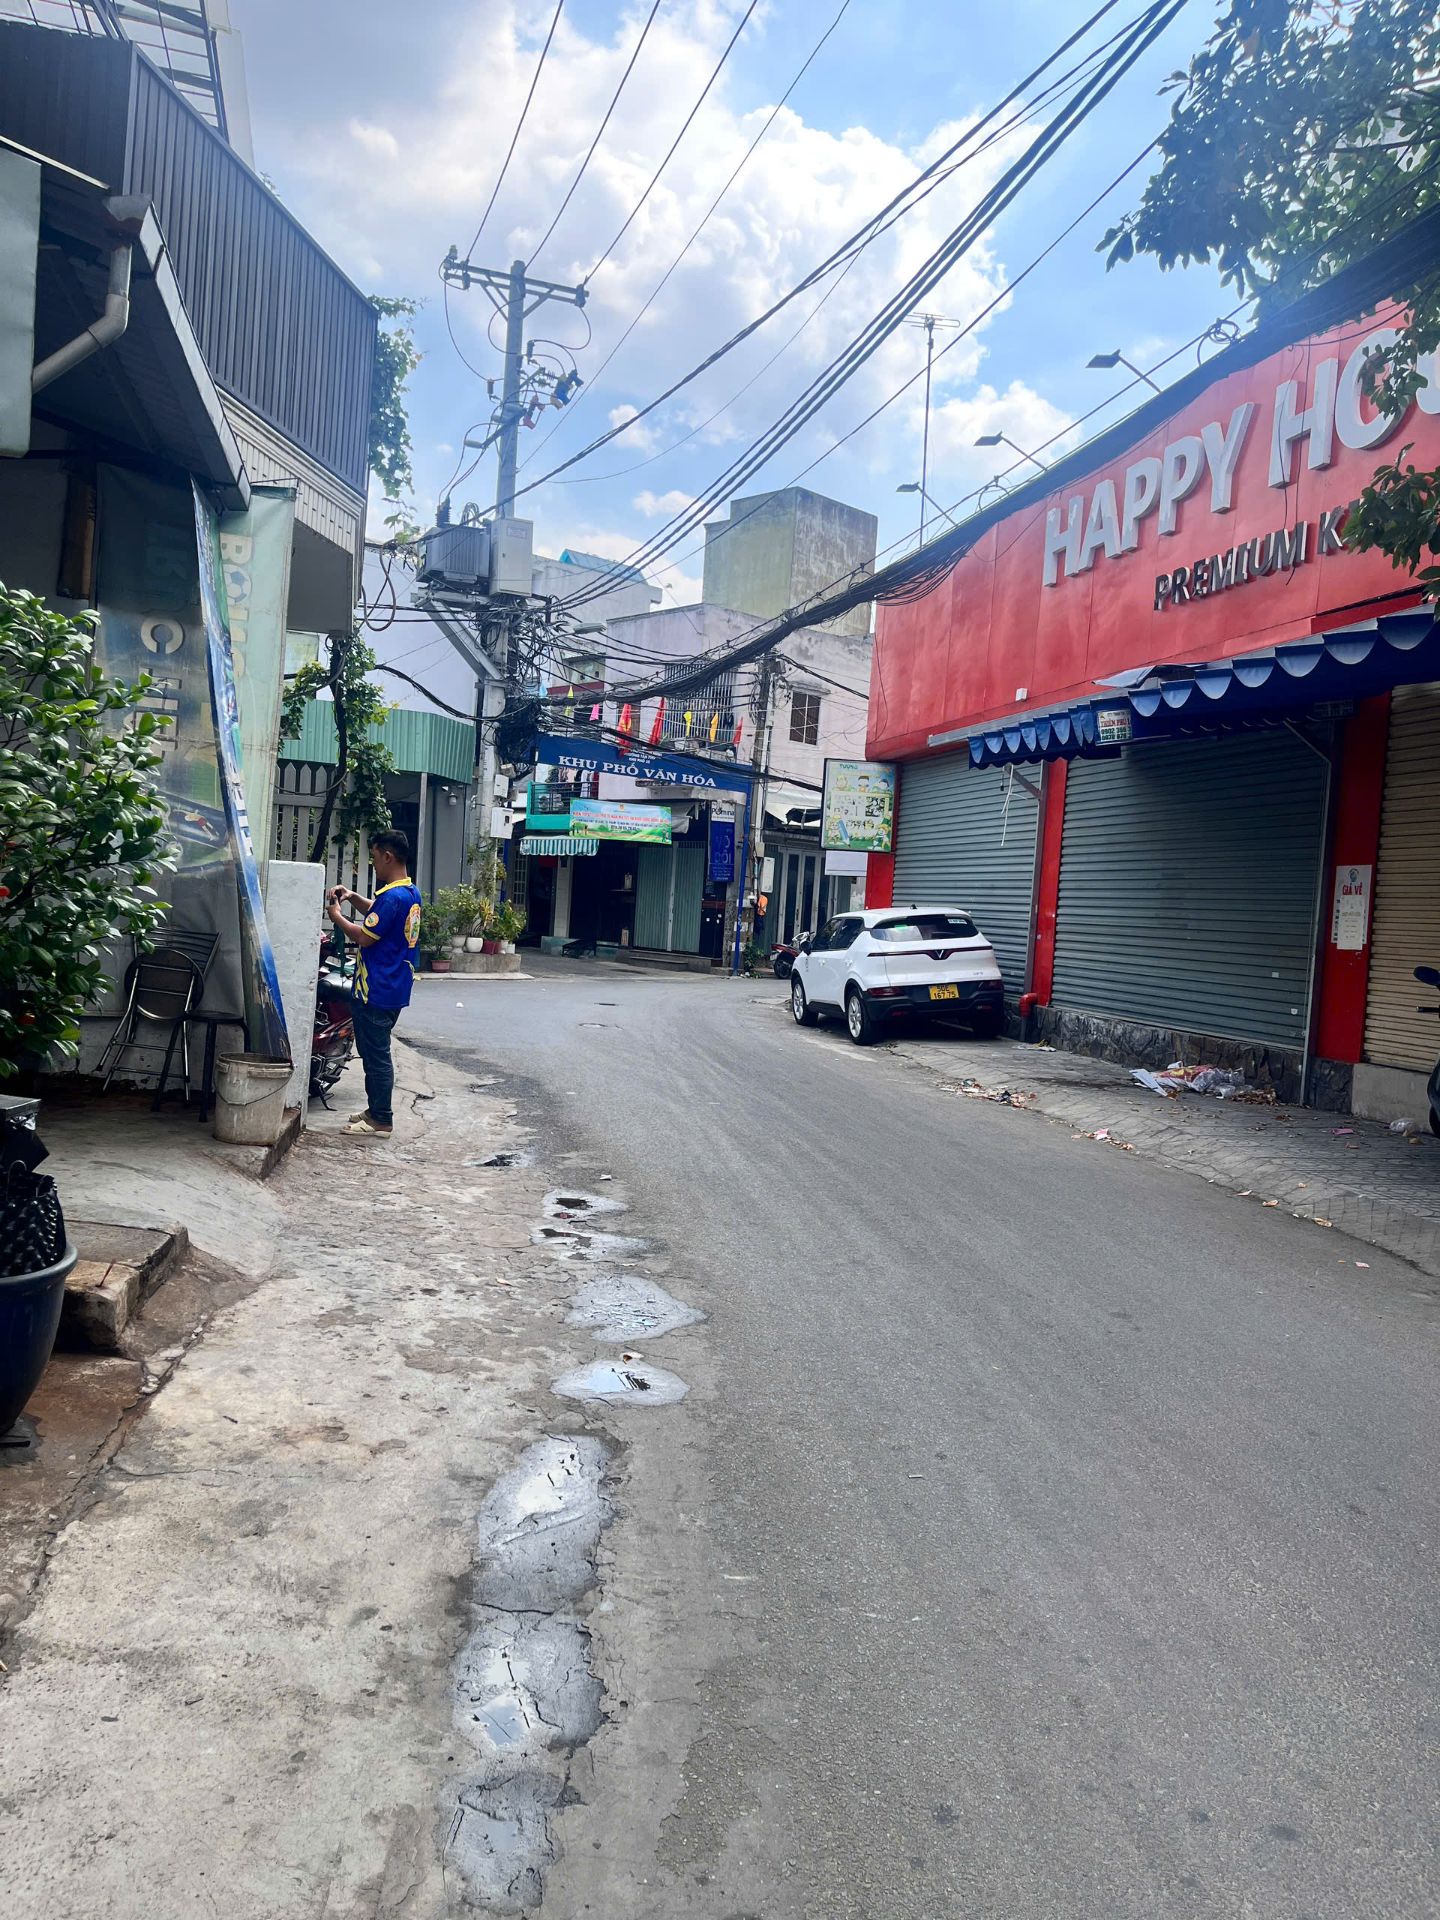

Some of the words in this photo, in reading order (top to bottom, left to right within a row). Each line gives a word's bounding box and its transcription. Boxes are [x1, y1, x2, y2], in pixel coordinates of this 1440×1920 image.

[1043, 402, 1255, 587] HAPPY
[1154, 521, 1308, 611] PREMIUM
[558, 755, 597, 770] KHU
[602, 761, 639, 776] PHỐ
[644, 768, 677, 783] VĂN
[681, 773, 717, 788] HÓA
[1342, 882, 1353, 896] GIÁ
